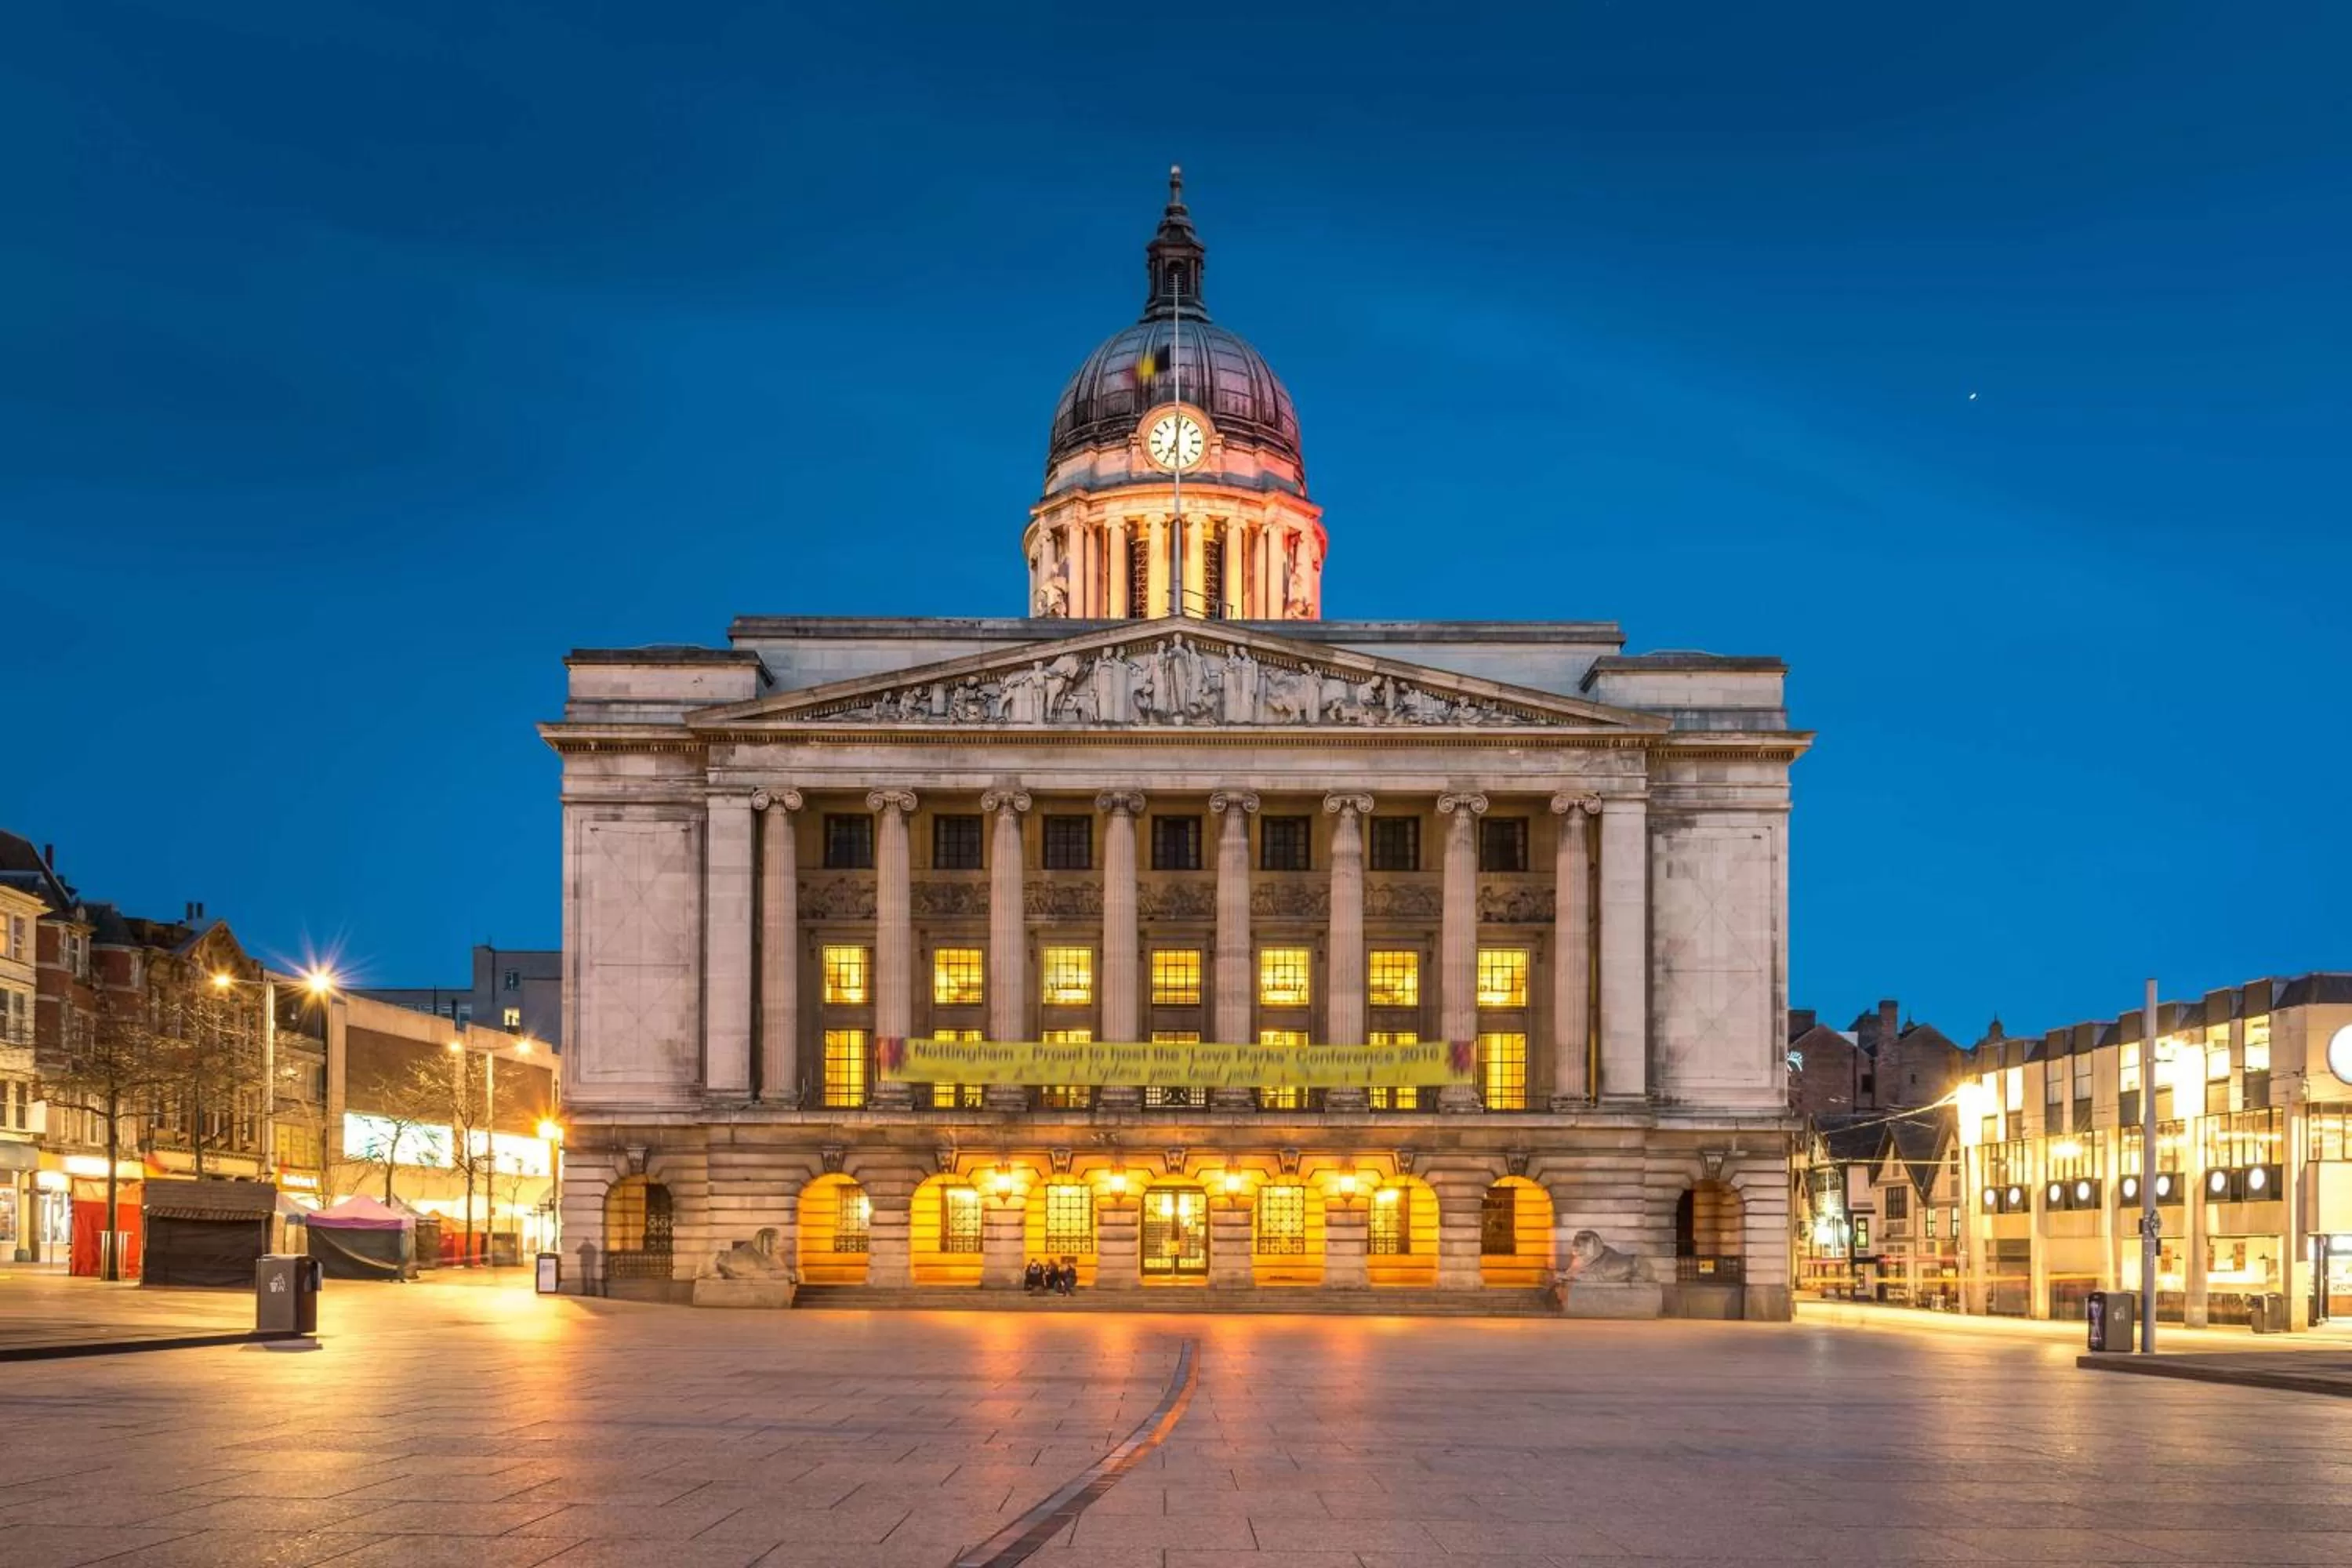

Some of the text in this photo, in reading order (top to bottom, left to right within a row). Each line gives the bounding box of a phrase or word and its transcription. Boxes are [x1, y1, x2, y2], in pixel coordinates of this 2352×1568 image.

[914, 1042, 1014, 1064] Nottingham
[1032, 1046, 1083, 1061] Proud
[1089, 1047, 1105, 1061] to
[1110, 1047, 1147, 1062] host
[1153, 1047, 1180, 1062] the
[1295, 1049, 1395, 1065] Conference
